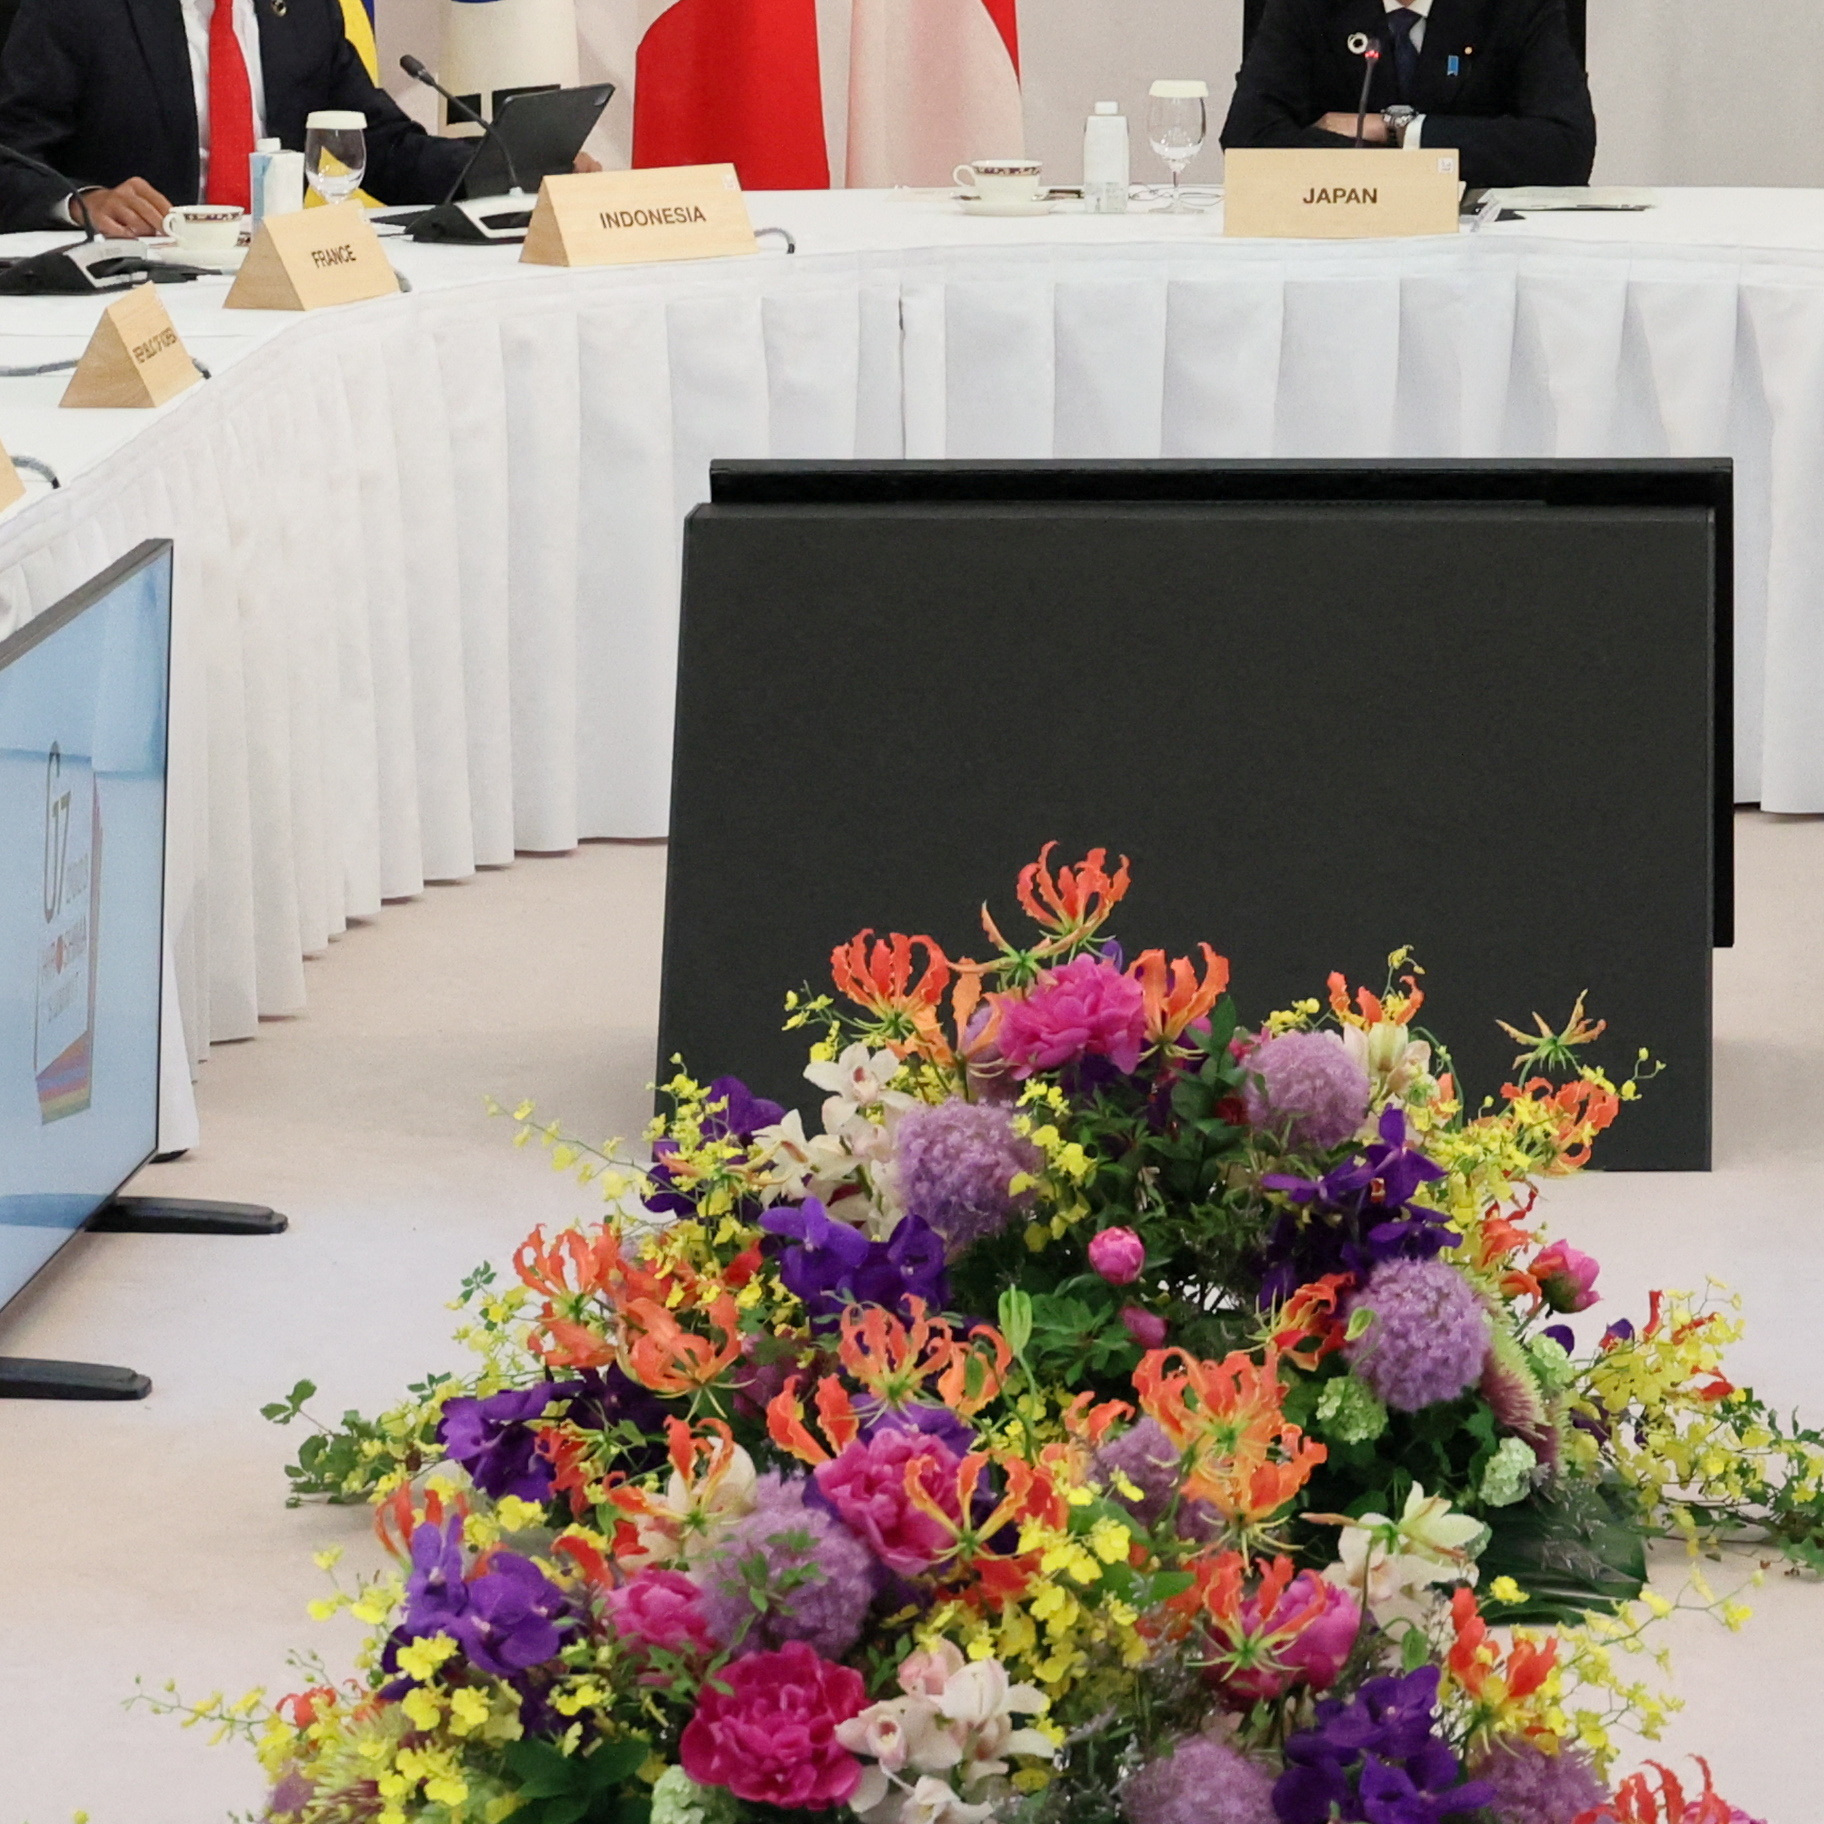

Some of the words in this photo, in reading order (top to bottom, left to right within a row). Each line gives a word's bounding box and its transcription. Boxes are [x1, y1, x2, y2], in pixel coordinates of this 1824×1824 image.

[1302, 187, 1379, 205] JAPAN
[599, 205, 707, 230] INDONESIA
[310, 244, 358, 270] FRANCE
